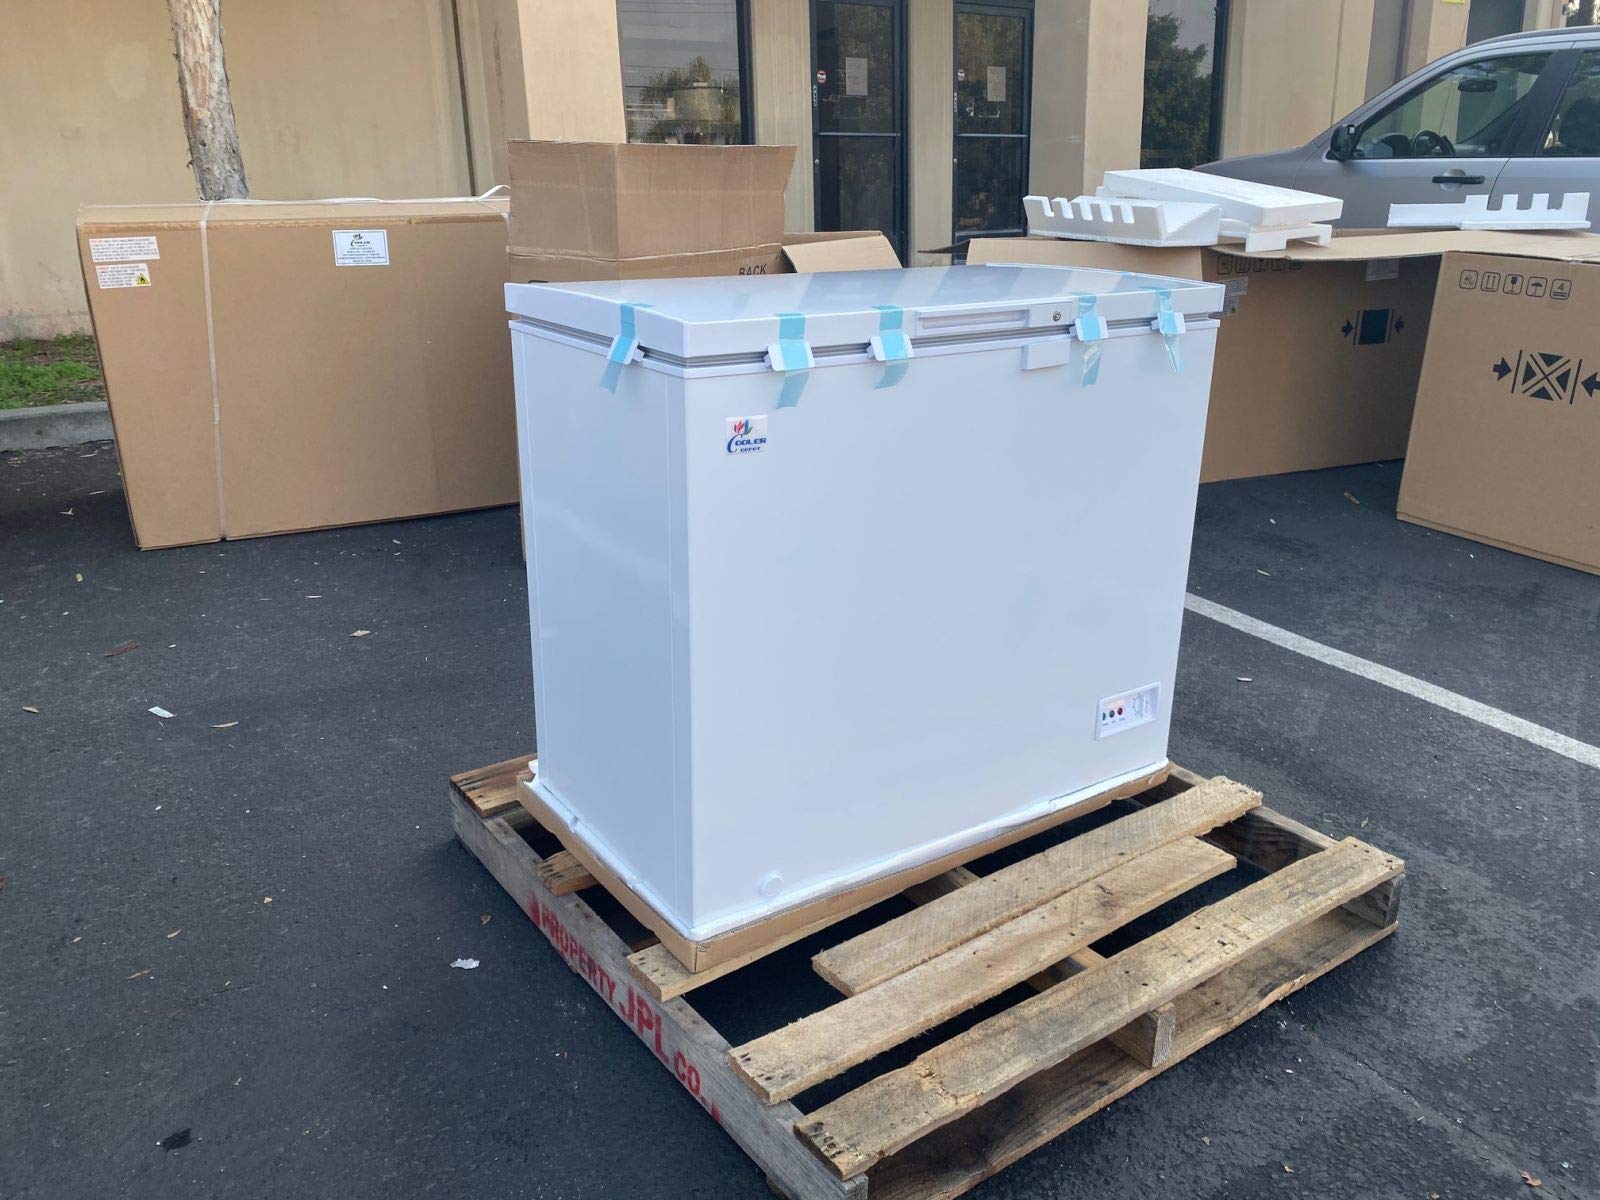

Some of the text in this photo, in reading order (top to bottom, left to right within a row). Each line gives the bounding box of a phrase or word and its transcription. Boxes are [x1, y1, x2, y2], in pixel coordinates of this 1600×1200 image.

[727, 434, 767, 454] COOLER
[540, 905, 617, 1002] PROPERTY
[619, 984, 669, 1063] JPL
